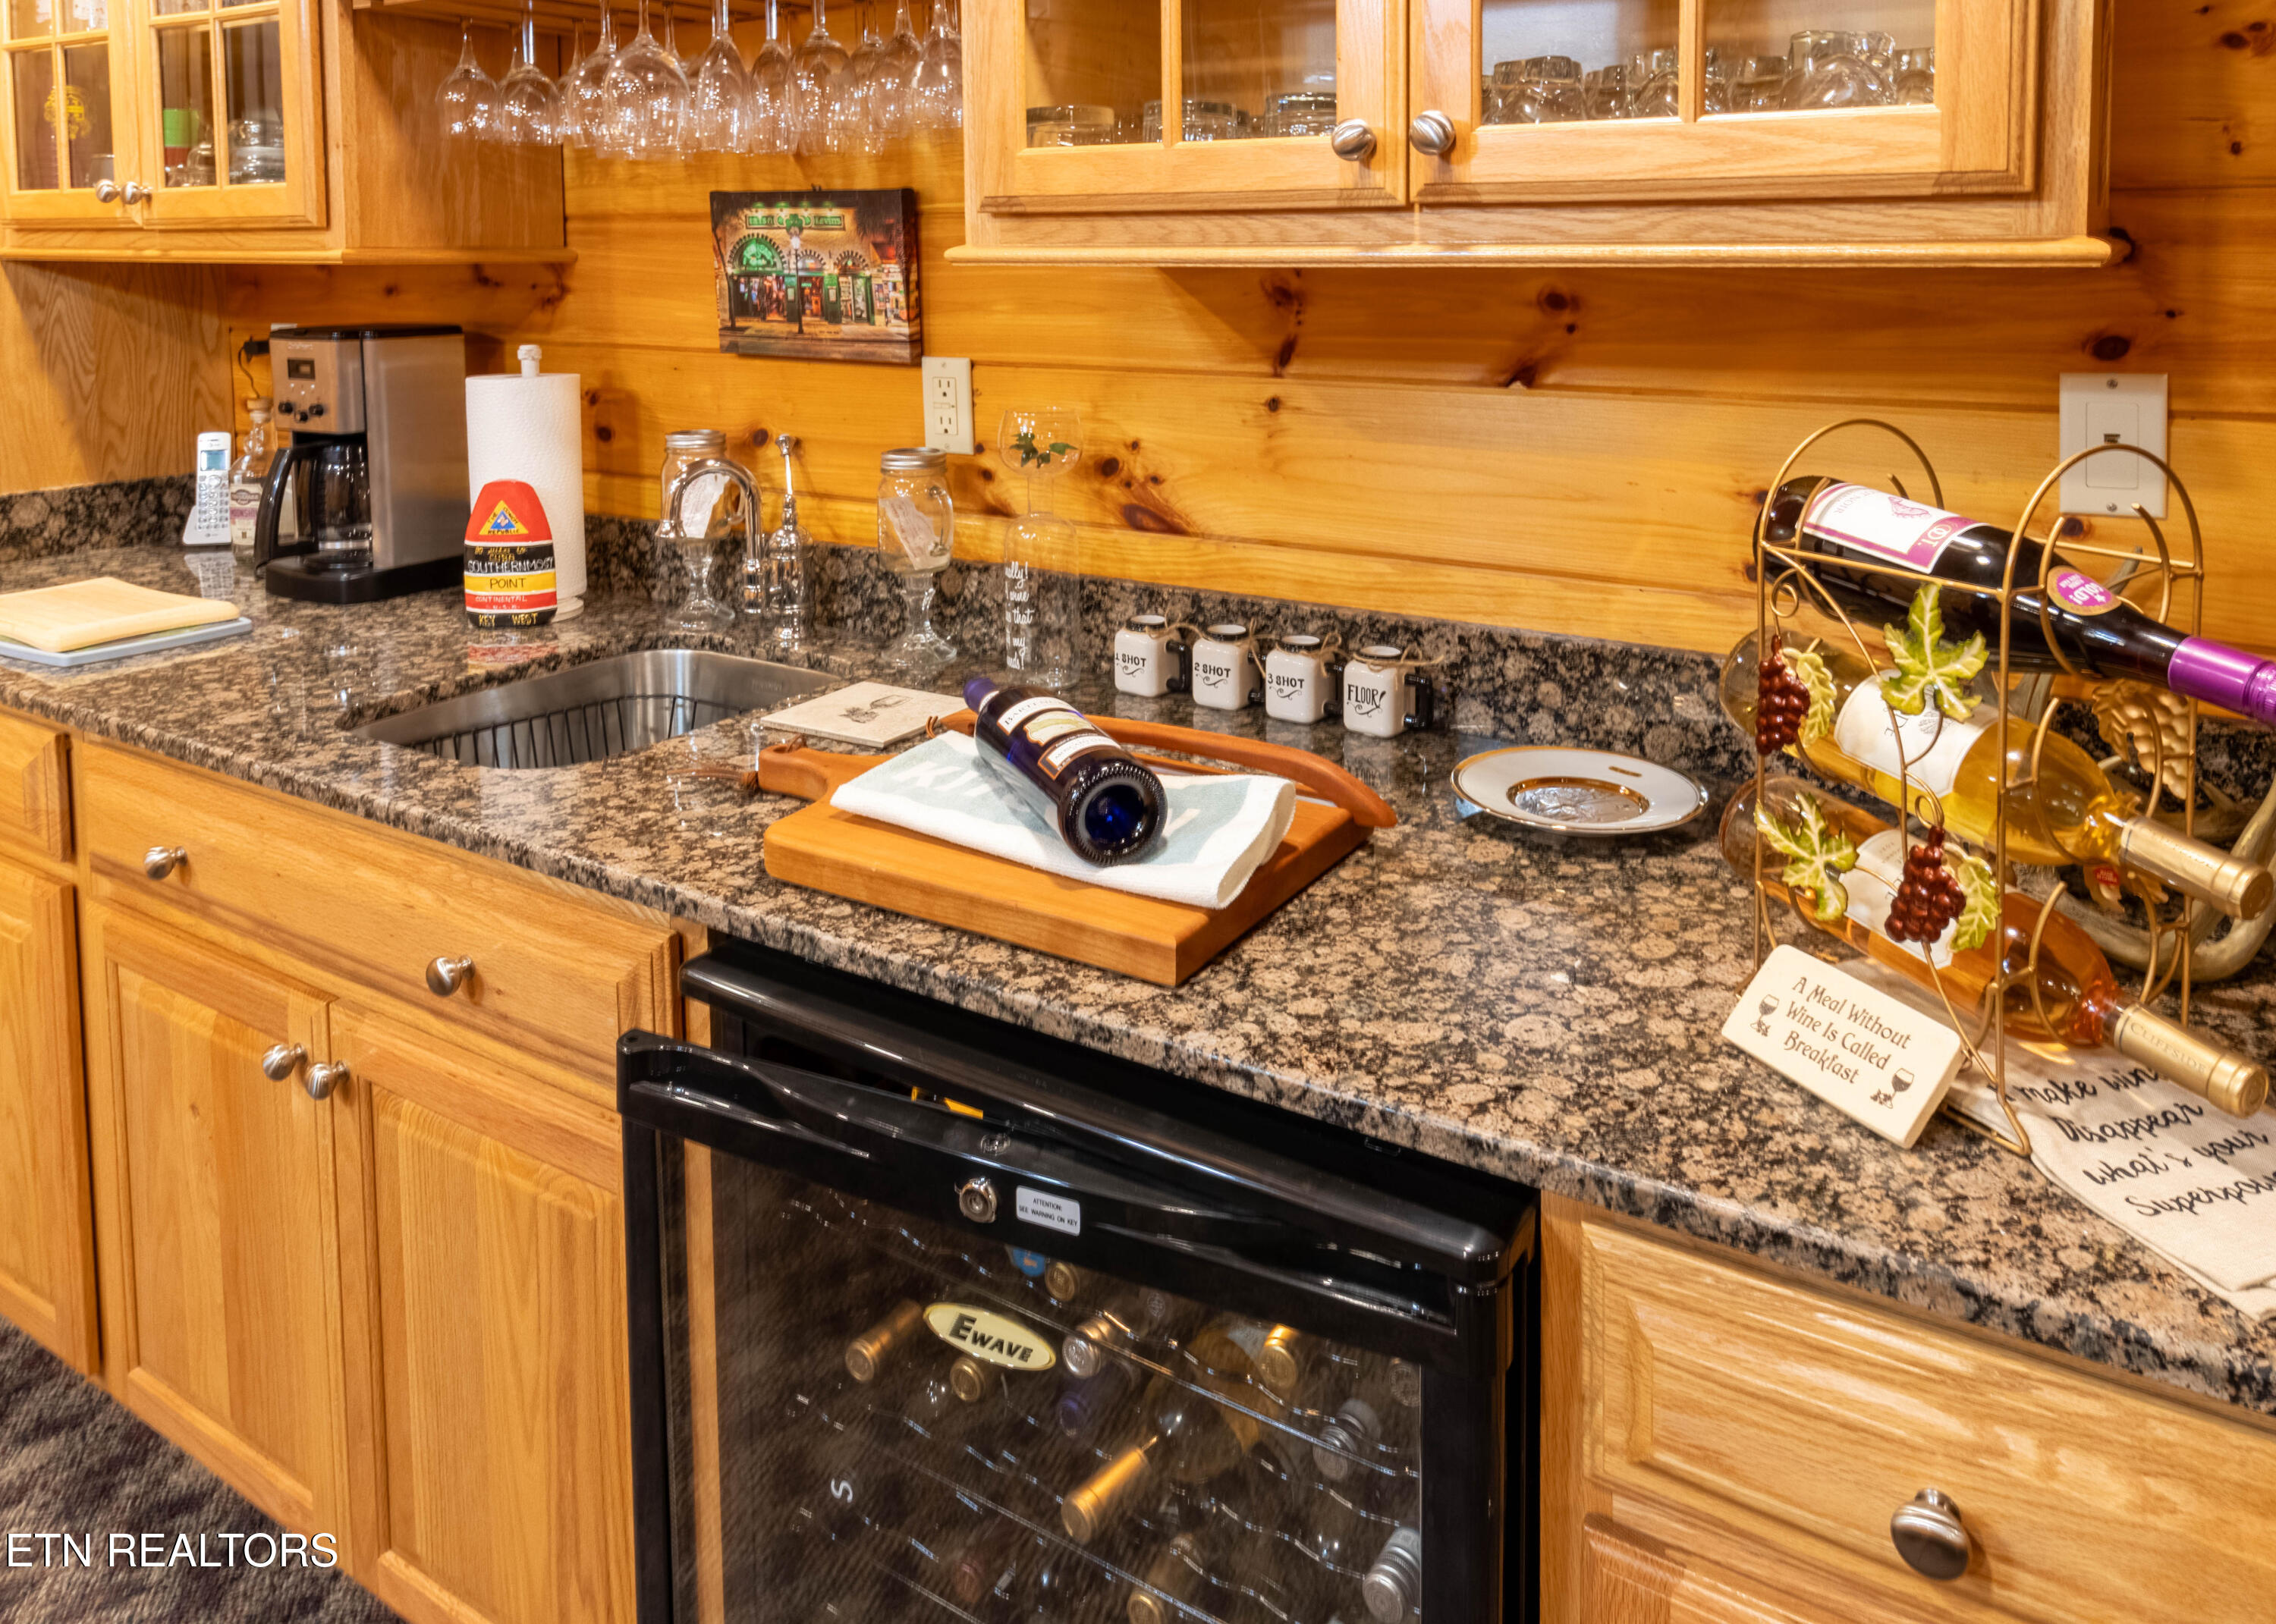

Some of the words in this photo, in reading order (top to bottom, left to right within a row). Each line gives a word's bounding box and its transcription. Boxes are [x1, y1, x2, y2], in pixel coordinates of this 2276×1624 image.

[467, 556, 554, 573] SOUTHERNMOST
[490, 578, 527, 589] POINT
[475, 595, 527, 603] CONTINENTAL
[479, 613, 495, 627] KEY
[512, 613, 539, 625] WEST
[1011, 606, 1036, 625] that
[1115, 652, 1120, 661] 1
[1122, 653, 1147, 668] SHOT
[1194, 662, 1200, 671] 2
[1202, 664, 1231, 678] SHOT
[1268, 674, 1274, 684] 3
[1276, 675, 1305, 689] SHOT
[1347, 683, 1387, 708] FLOOR!
[1792, 976, 1808, 994] A
[1806, 985, 1847, 1014] Meal
[1847, 1004, 1912, 1049] Without
[1785, 1000, 1822, 1032] Wine
[1822, 1022, 1839, 1041] Is
[1841, 1032, 1891, 1070] Called
[1784, 1030, 1860, 1084] Breakfast
[2012, 1079, 2098, 1105] make
[2098, 1066, 2159, 1092] win
[2046, 1103, 2204, 1143] Disappear
[2082, 1146, 2193, 1185] what's
[2192, 1129, 2269, 1165] your
[2124, 1170, 2276, 1216] Superpow
[1019, 1205, 1028, 1214] SEE
[1031, 1208, 1055, 1220] WARNING
[1067, 1218, 1077, 1227] KEY
